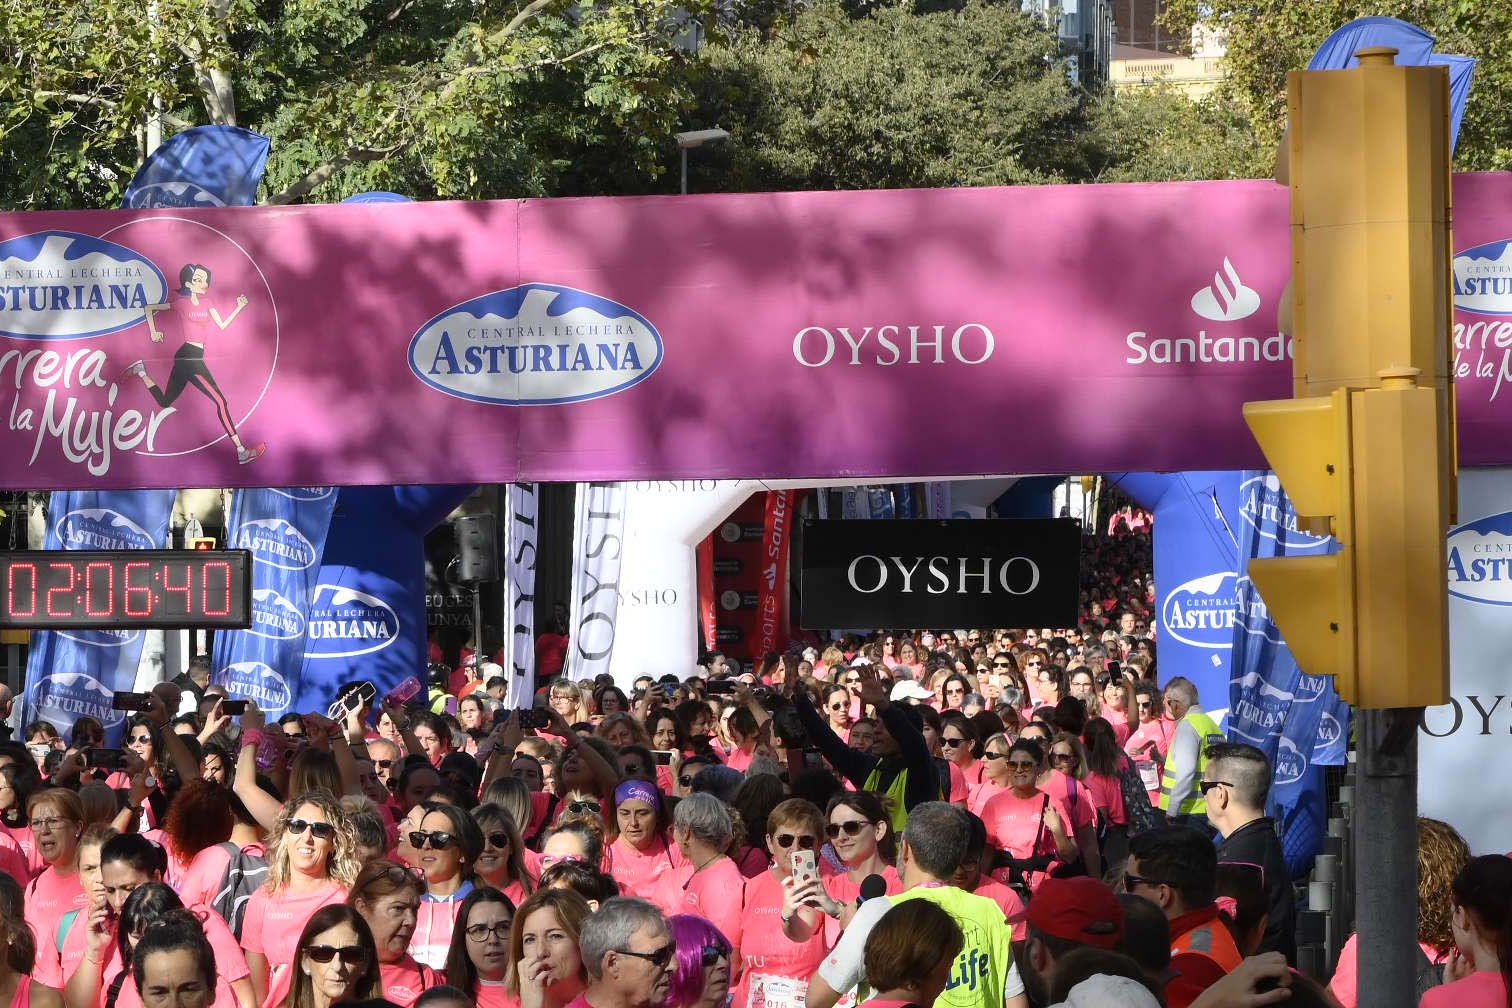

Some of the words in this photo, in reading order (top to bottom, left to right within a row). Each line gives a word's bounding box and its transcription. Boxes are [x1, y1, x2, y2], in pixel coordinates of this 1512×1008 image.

[71, 266, 143, 278] LECHERA
[428, 330, 644, 376] ASTURIANA
[467, 327, 545, 341] CENTRAL
[554, 324, 635, 337] LECHERA
[791, 323, 995, 368] OYSHO
[1126, 331, 1294, 365] Santand
[1476, 350, 1494, 378] la
[9, 390, 34, 431] la
[28, 382, 177, 477] Mujer
[238, 513, 309, 564] ASTURIANA
[8, 562, 231, 617] 02:06:40
[846, 554, 1040, 595] OYSHO
[336, 609, 385, 618] LECHERA
[946, 947, 990, 991] Life
